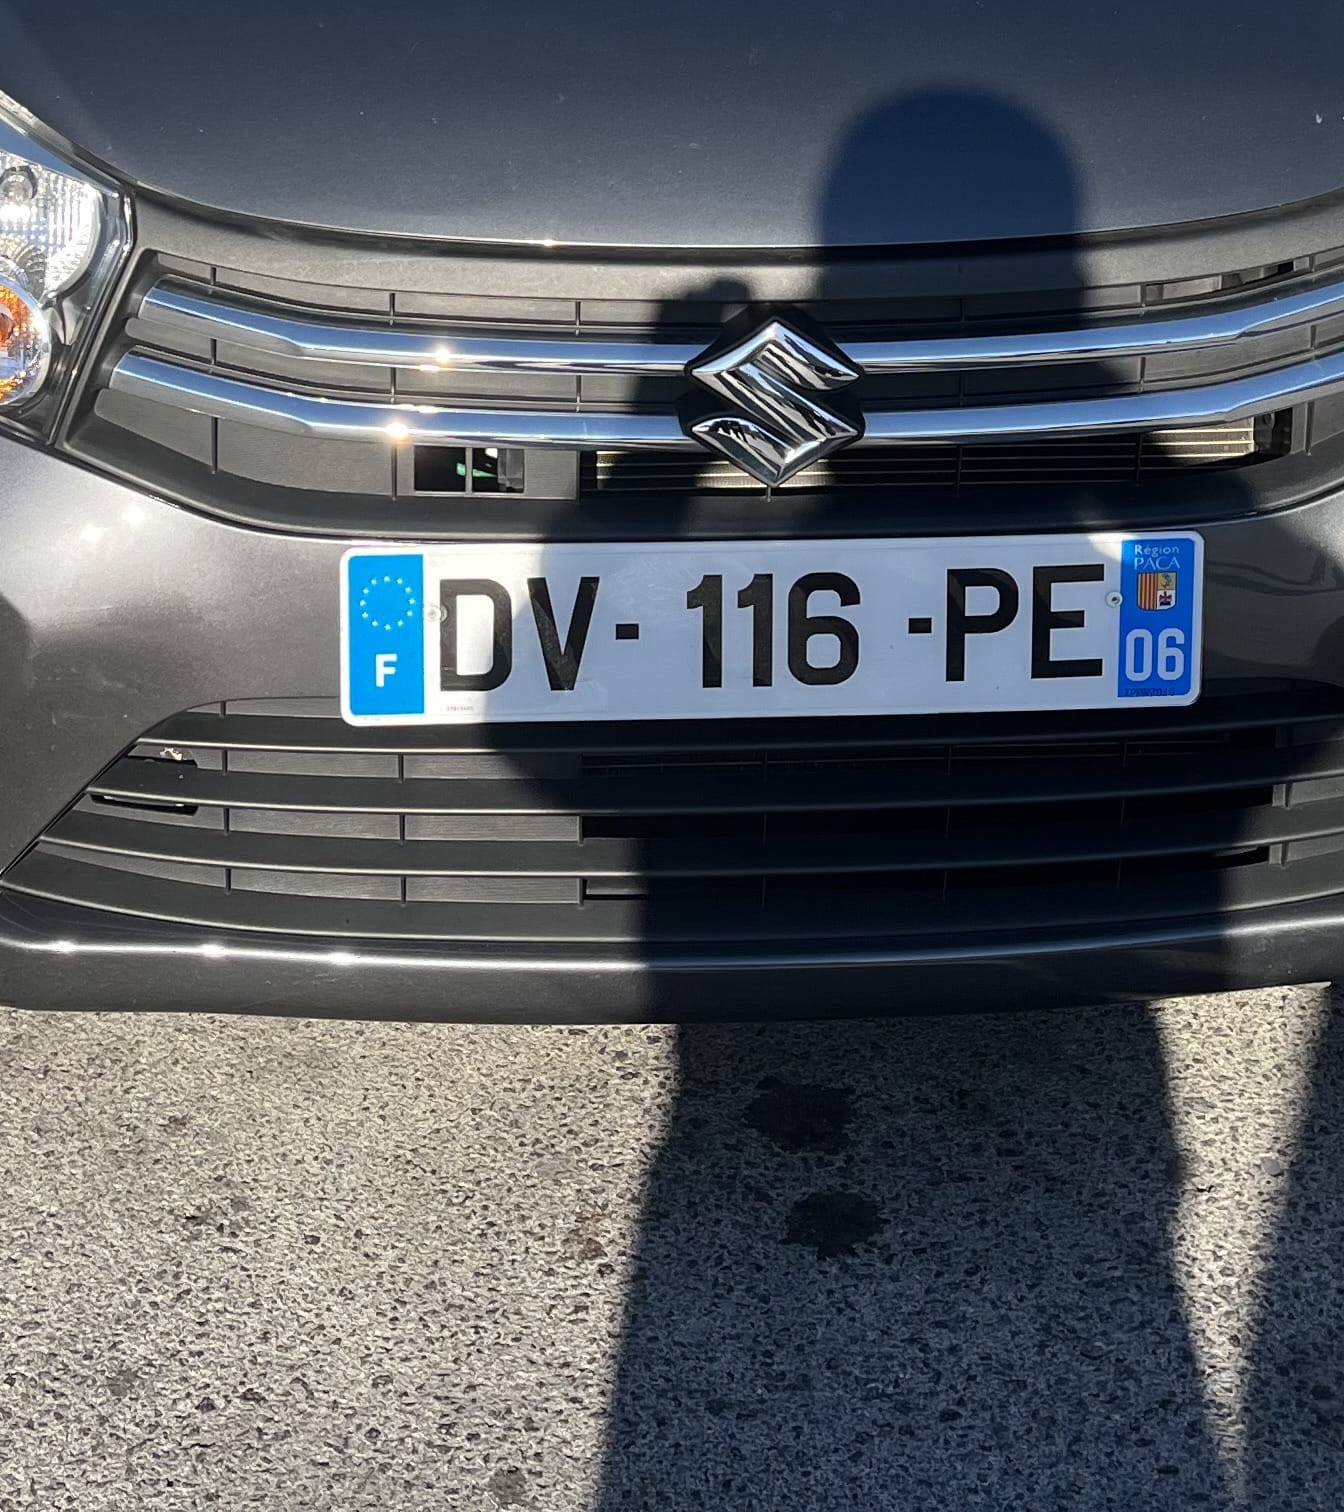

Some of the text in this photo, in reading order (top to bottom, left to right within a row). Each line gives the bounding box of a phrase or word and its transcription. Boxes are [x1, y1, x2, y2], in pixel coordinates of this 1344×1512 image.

[1133, 556, 1181, 570] PACA
[1134, 544, 1180, 558] Région
[1125, 627, 1185, 682] 06
[375, 653, 398, 688] F
